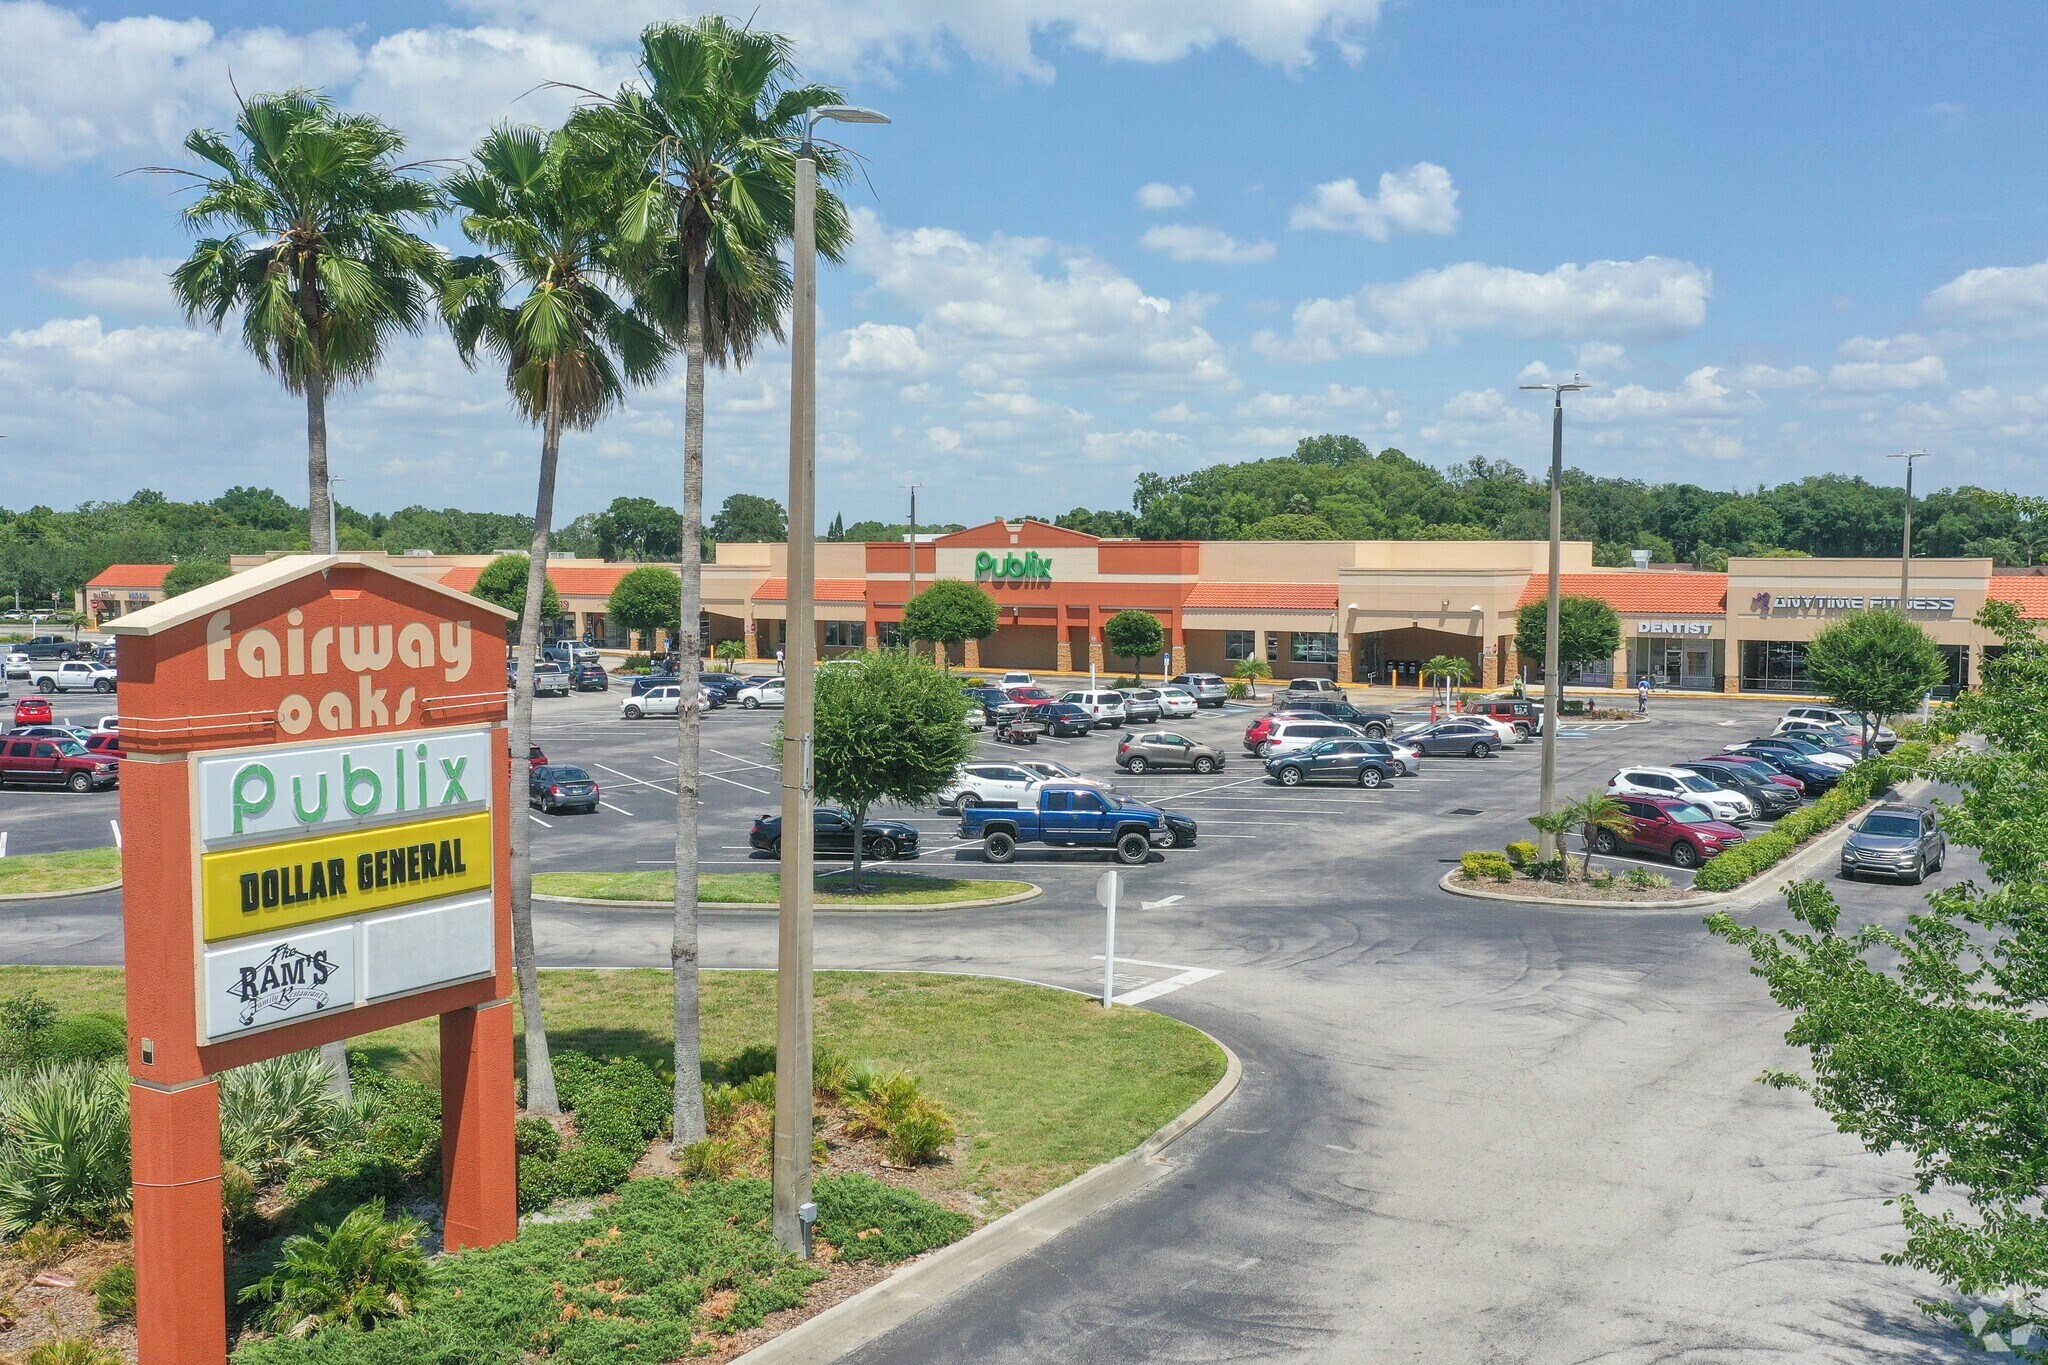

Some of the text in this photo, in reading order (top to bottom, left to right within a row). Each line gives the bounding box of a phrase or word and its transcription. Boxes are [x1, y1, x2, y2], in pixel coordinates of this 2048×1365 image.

[976, 551, 1052, 578] Publix
[1773, 595, 1864, 609] ANYTIME
[207, 608, 472, 682] fairway
[1638, 622, 1712, 634] DENTIST
[279, 675, 416, 735] oaks
[233, 743, 468, 833] Publix
[241, 838, 466, 913] DOLLAR GENERAL
[271, 943, 297, 964] The
[240, 950, 328, 1004] RAM'S
[280, 986, 324, 1004] Restaurant
